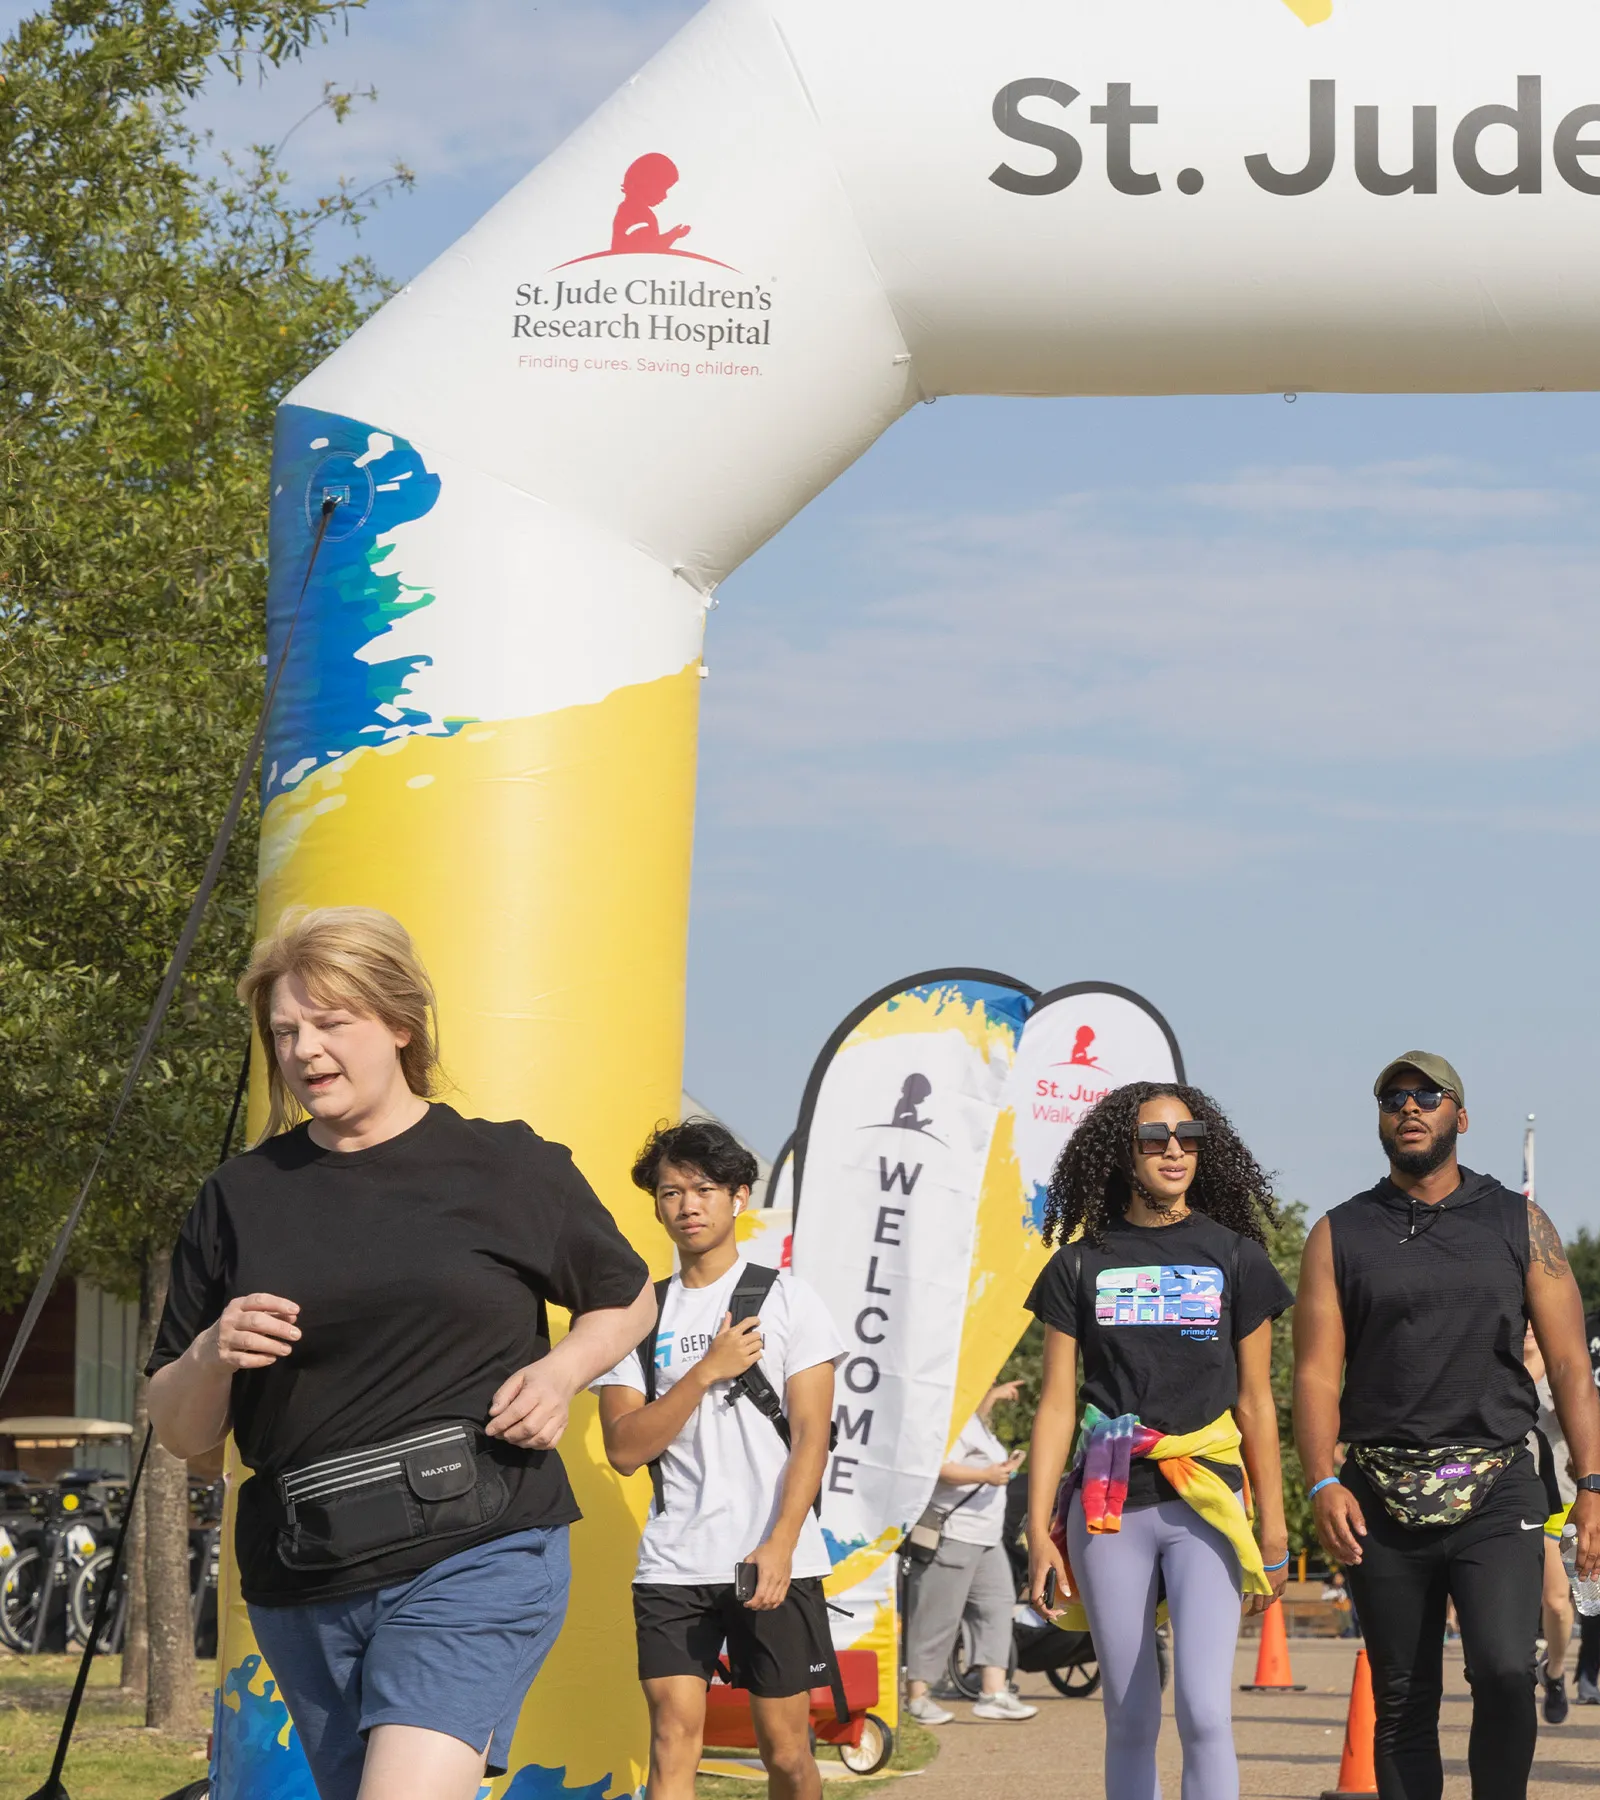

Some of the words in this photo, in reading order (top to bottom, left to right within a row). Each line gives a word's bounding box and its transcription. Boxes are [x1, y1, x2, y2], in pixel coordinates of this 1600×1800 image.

[988, 77, 1205, 197] St.
[515, 283, 549, 307] St.
[552, 279, 618, 311] Jude
[625, 279, 773, 311] Children's
[512, 313, 641, 339] Research
[648, 314, 771, 351] Hospital
[518, 355, 579, 373] Finding
[584, 358, 632, 371] cures.
[637, 357, 690, 377] Saving
[695, 360, 763, 377] children.
[1036, 1079, 1064, 1099] St.
[828, 1155, 924, 1496] WELCOME
[1181, 1327, 1205, 1337] prime
[1205, 1328, 1218, 1338] day
[421, 1462, 462, 1478] MAXTOP
[809, 1662, 827, 1673] MP
